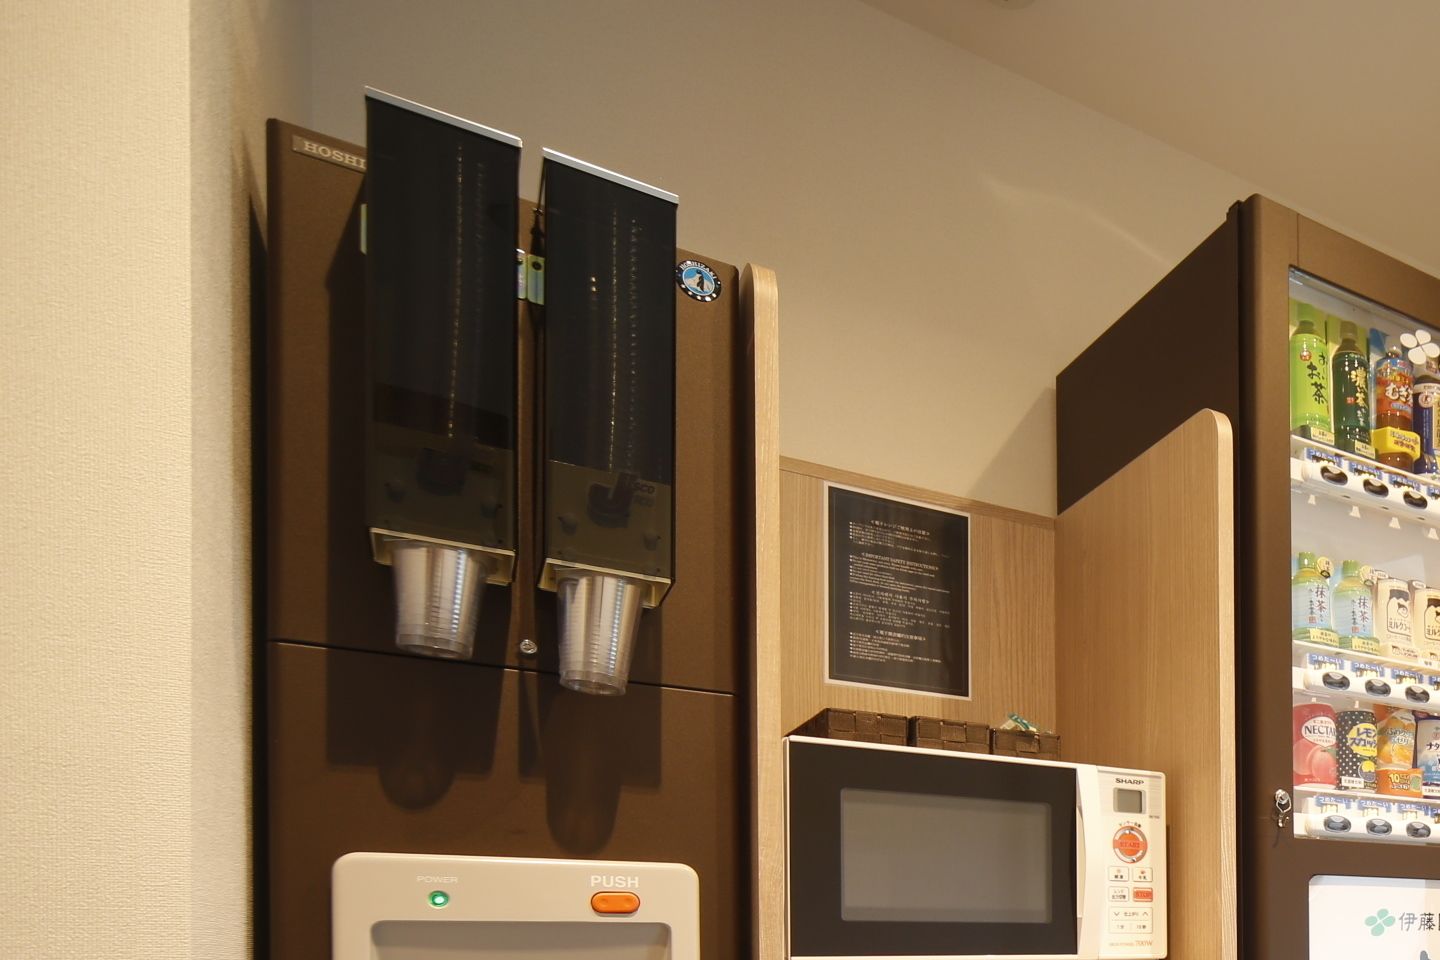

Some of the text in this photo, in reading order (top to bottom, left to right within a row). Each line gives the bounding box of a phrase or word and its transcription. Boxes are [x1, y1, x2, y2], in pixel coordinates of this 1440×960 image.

[1115, 777, 1145, 786] SHARP
[416, 875, 458, 885] POWER
[590, 875, 640, 889] PUSH
